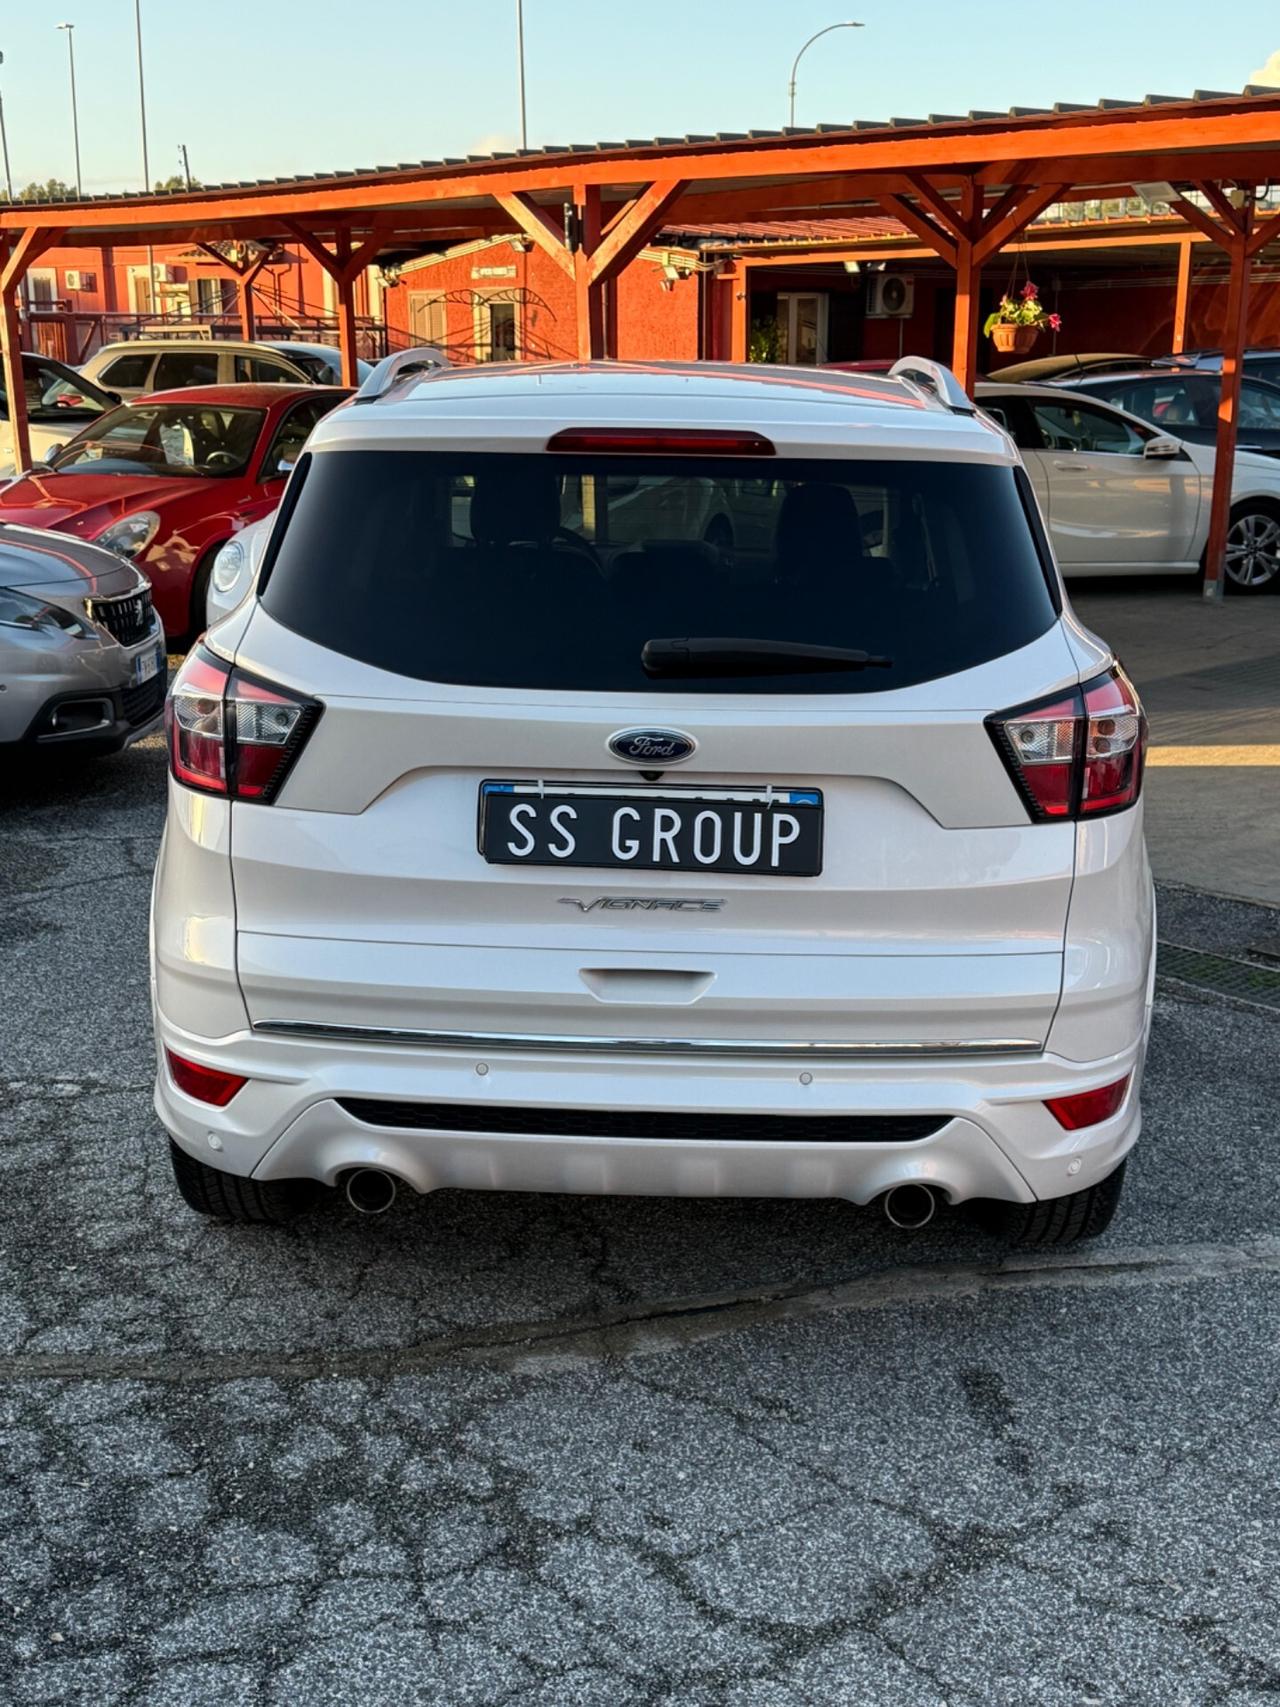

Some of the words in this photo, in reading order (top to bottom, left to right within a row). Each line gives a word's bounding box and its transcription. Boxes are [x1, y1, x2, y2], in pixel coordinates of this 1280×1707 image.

[629, 736, 676, 756] Ford
[507, 804, 578, 858] SS
[612, 806, 800, 867] GROUP
